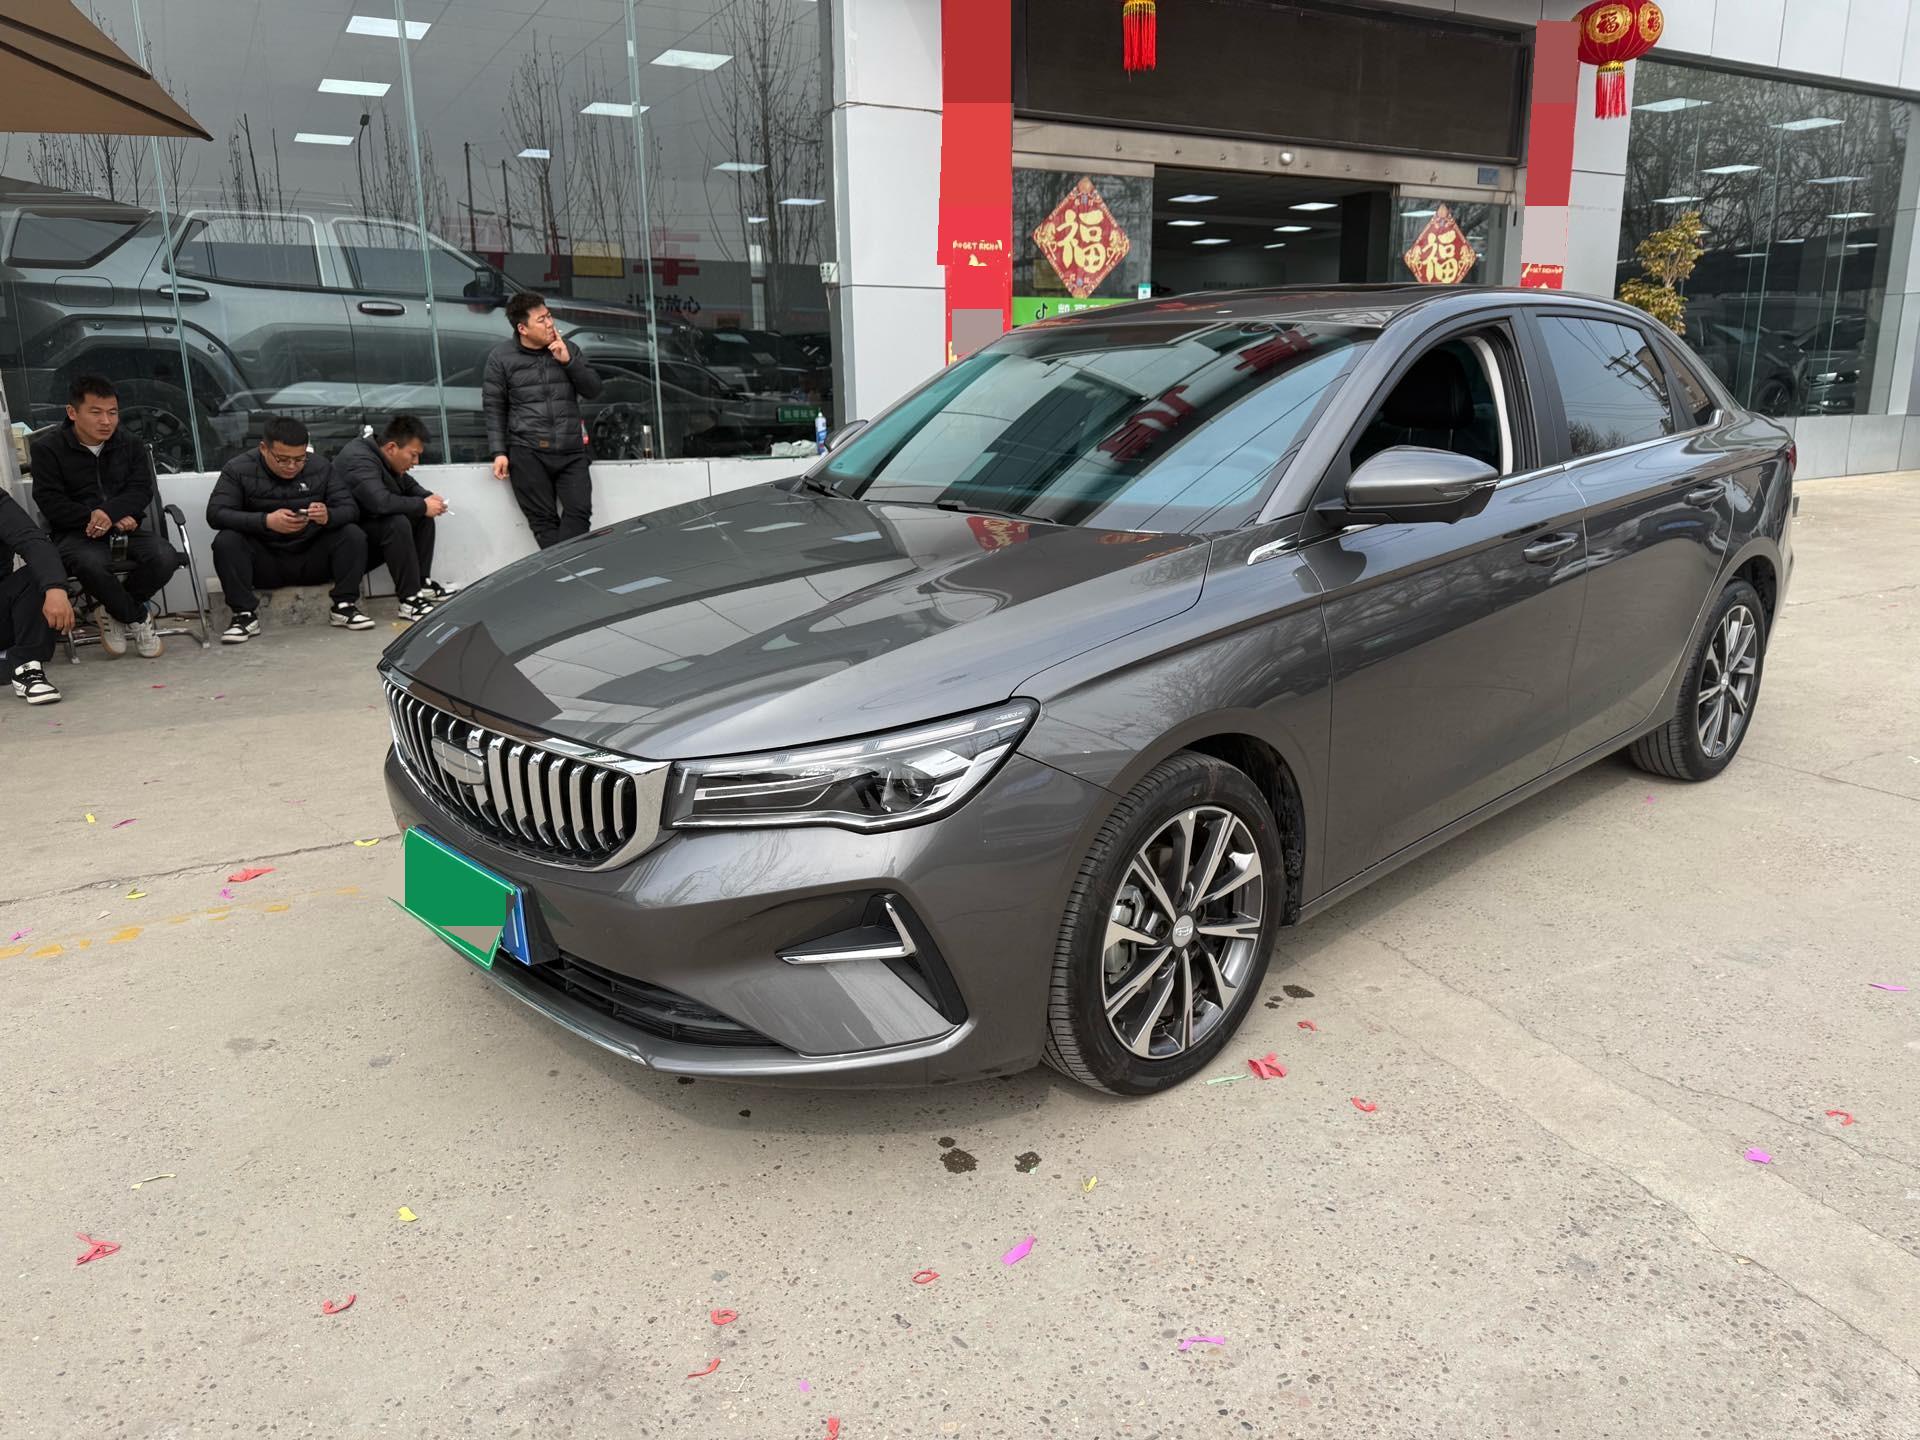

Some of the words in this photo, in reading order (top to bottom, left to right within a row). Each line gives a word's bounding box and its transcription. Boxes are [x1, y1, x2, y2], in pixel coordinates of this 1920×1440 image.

[1596, 11, 1620, 34] 福
[1647, 8, 1661, 32] 福
[1056, 209, 1106, 274] 福
[1421, 230, 1458, 284] 福
